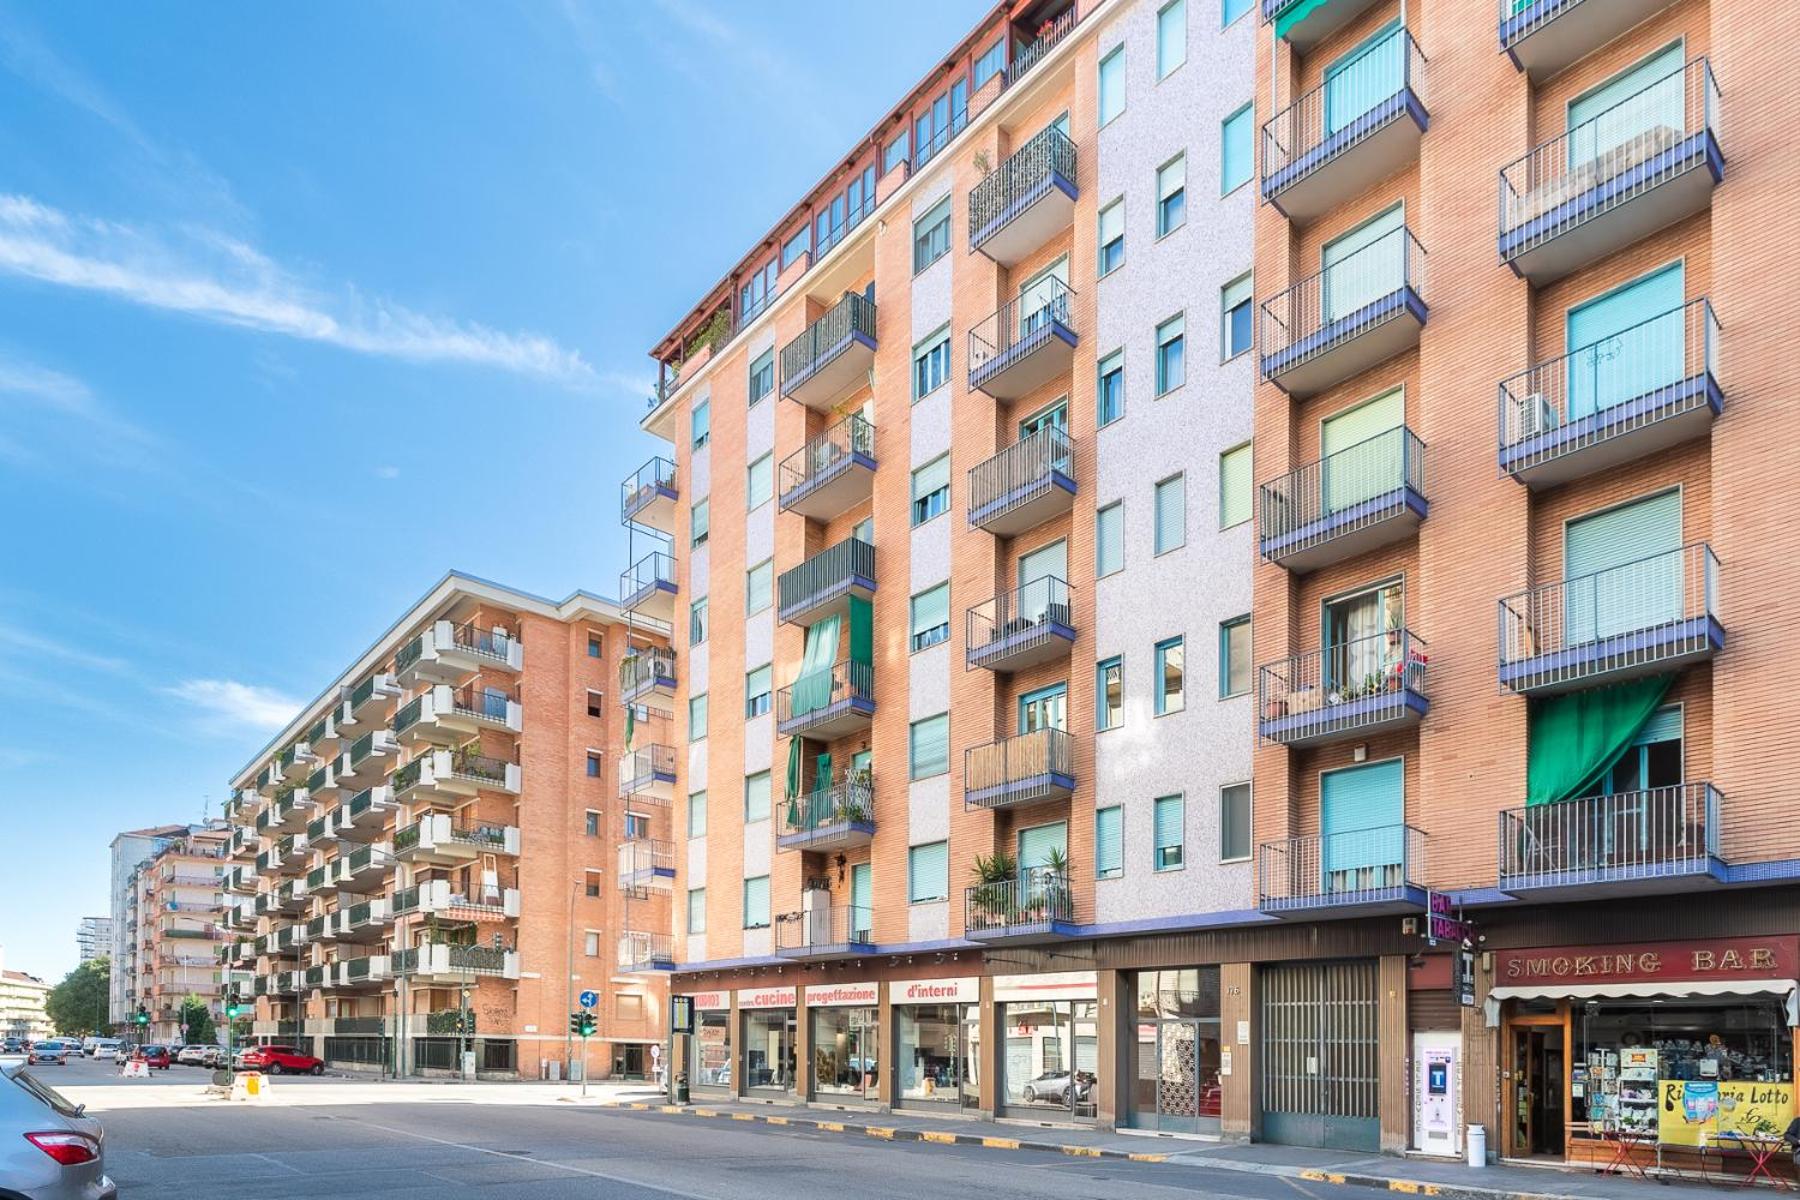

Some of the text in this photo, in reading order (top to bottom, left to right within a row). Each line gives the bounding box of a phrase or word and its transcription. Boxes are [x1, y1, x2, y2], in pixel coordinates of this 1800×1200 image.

[1507, 948, 1779, 977] SMOKING BAR
[754, 989, 795, 1006] cucine
[806, 986, 876, 1005] progettazione
[907, 982, 958, 999] d'interni
[1750, 1086, 1789, 1104] Lotto
